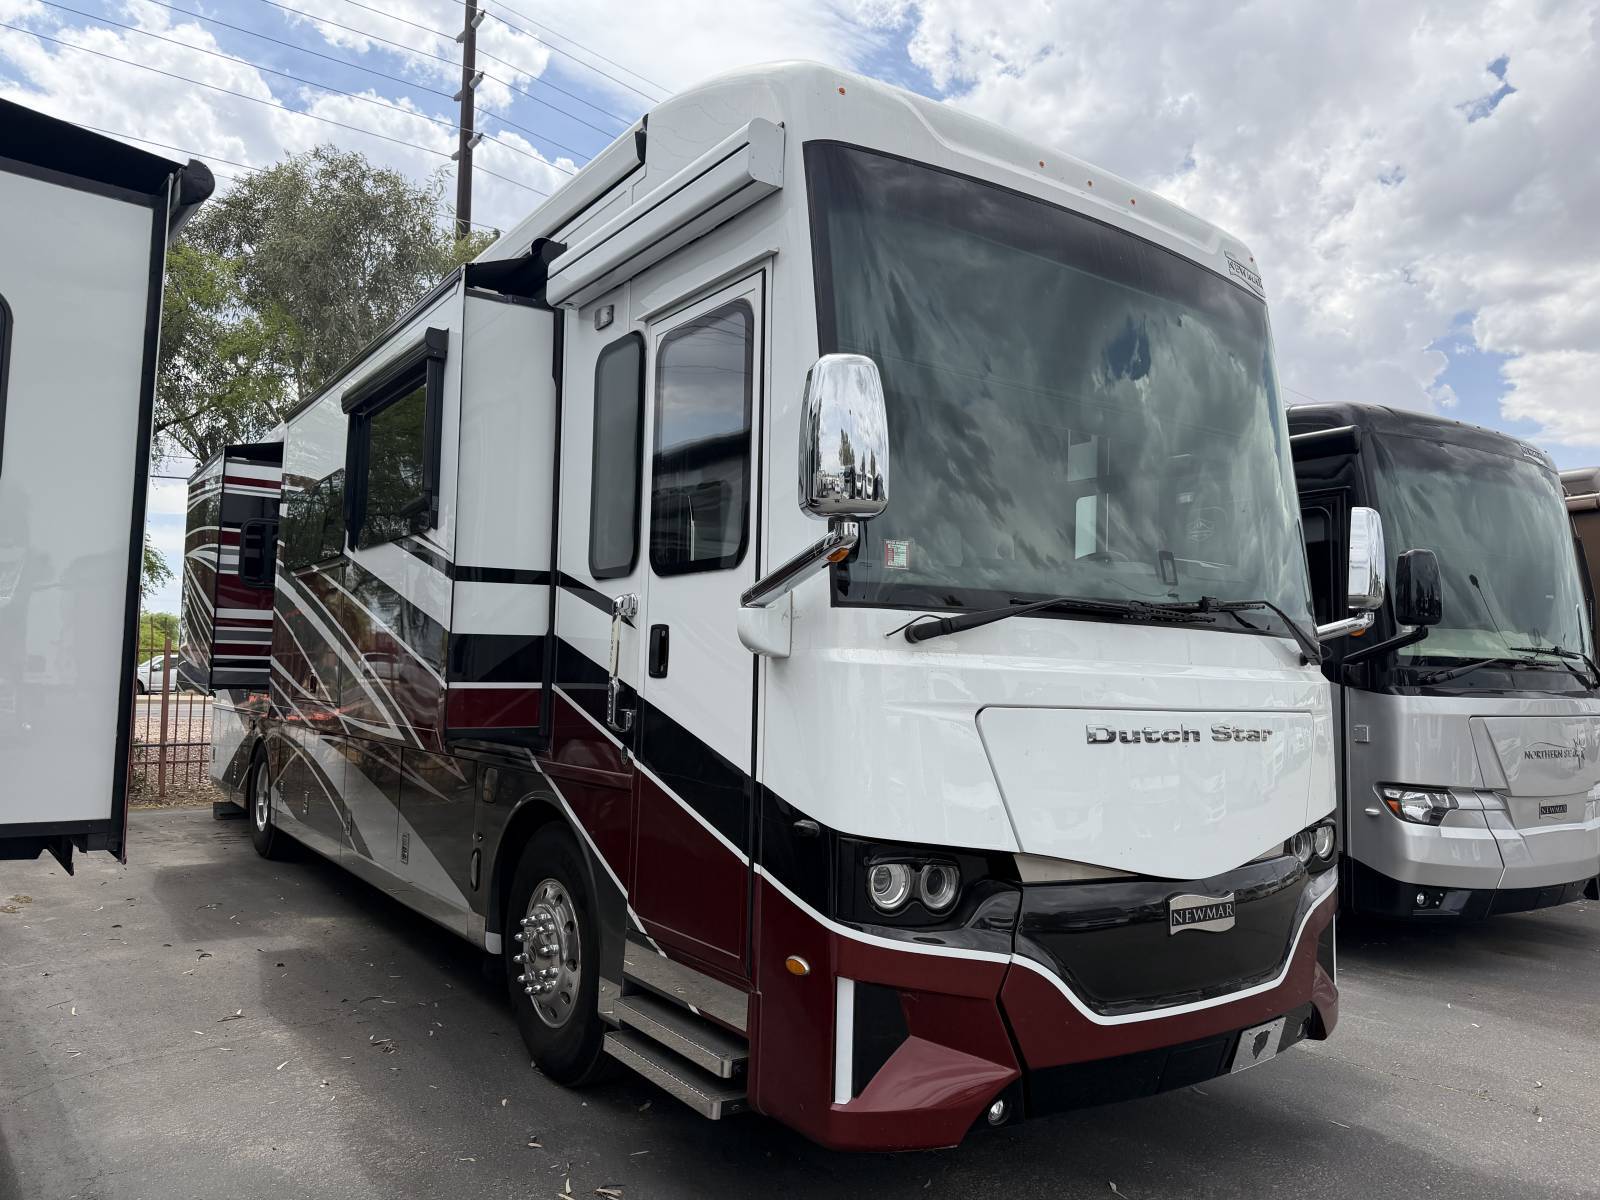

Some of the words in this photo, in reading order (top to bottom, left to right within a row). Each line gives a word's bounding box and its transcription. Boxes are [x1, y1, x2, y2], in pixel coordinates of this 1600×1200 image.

[1085, 722, 1201, 745] Dutch
[1210, 722, 1273, 743] Star
[1523, 749, 1563, 760] NORTHERN
[1540, 805, 1567, 815] NEWMAR
[1173, 903, 1234, 925] NEWMAR
